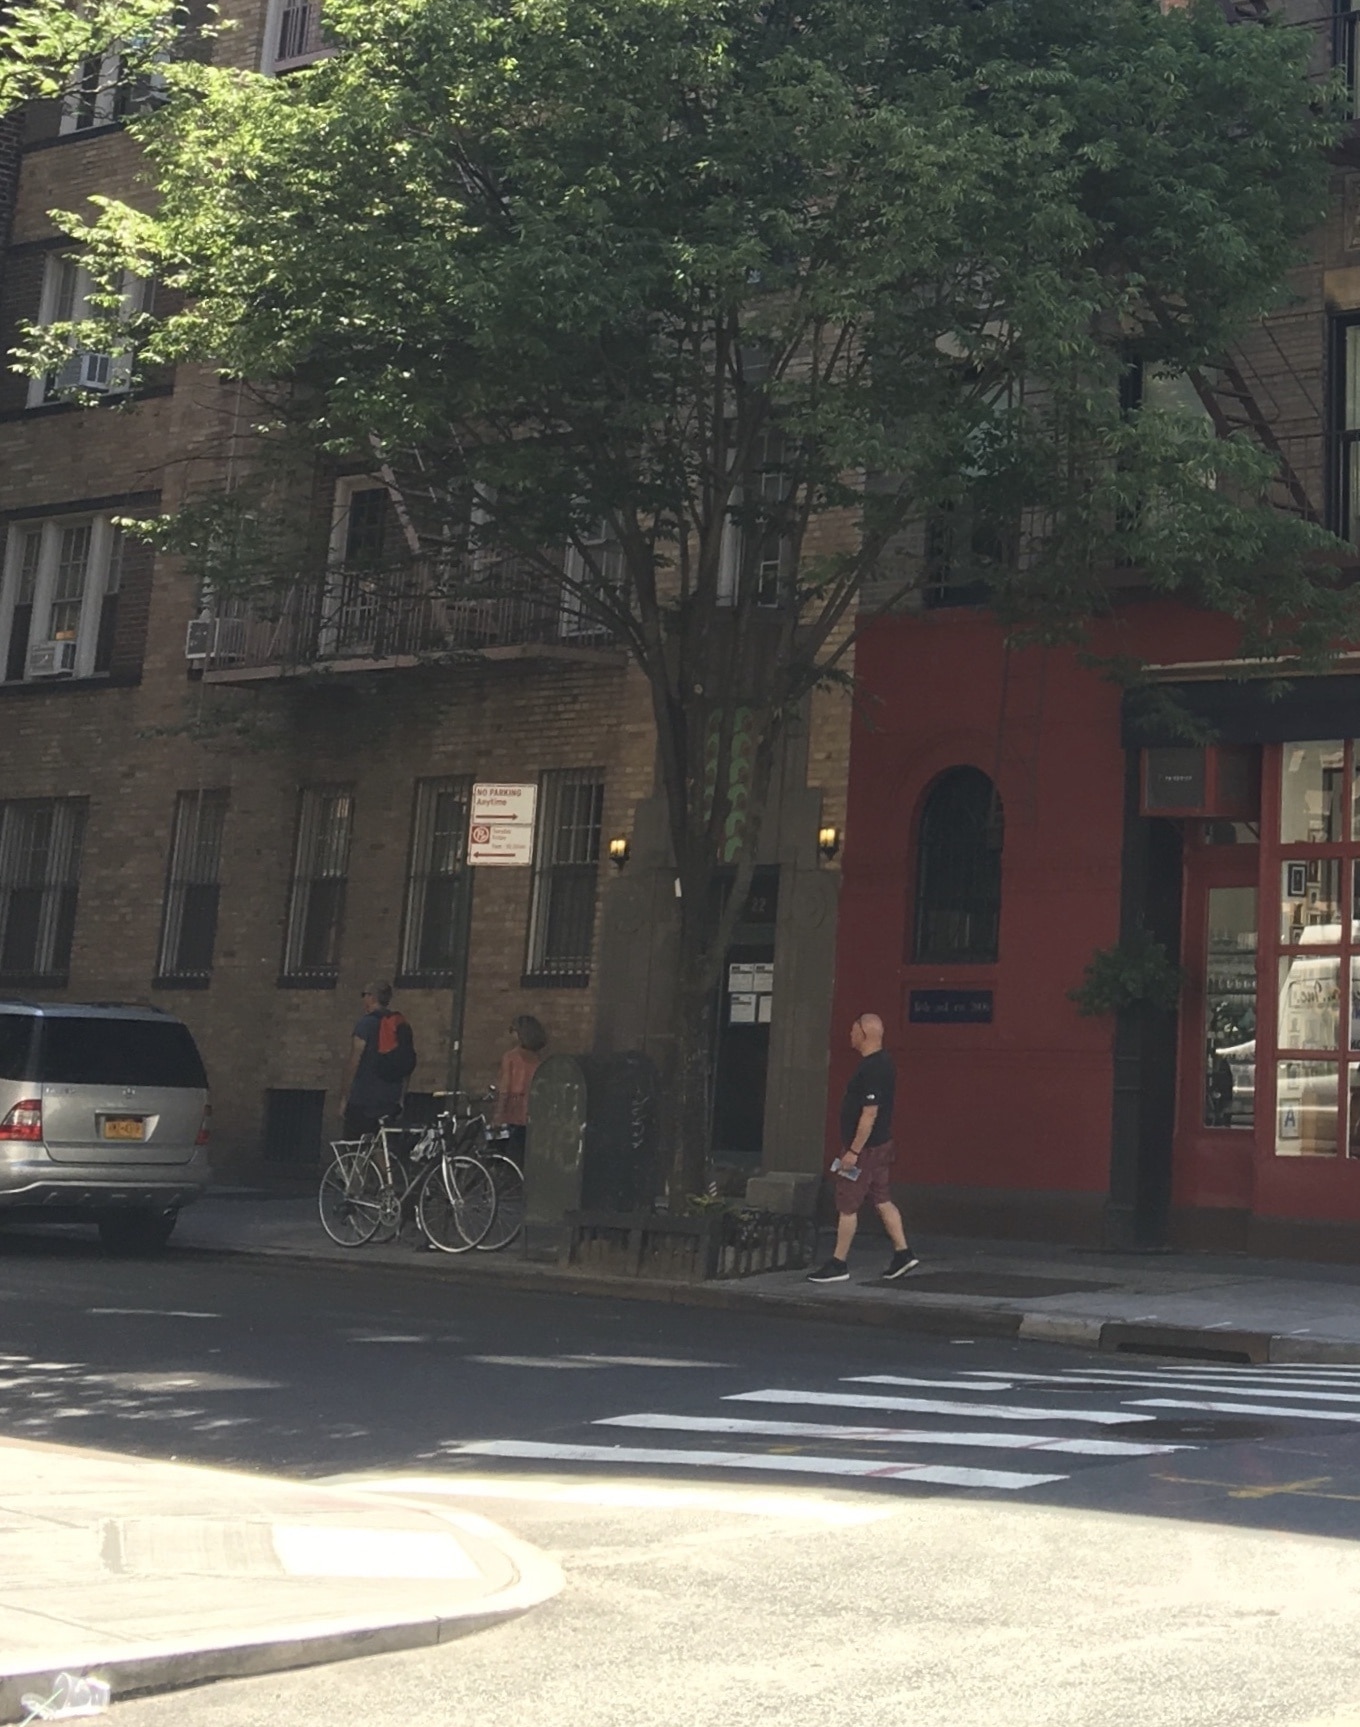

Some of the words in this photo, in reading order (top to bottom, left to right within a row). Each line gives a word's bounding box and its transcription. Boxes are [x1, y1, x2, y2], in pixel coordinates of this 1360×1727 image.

[476, 788, 488, 797] NO
[489, 788, 521, 797] PARKING
[476, 798, 507, 807] Anytime
[1284, 1106, 1296, 1128] A
